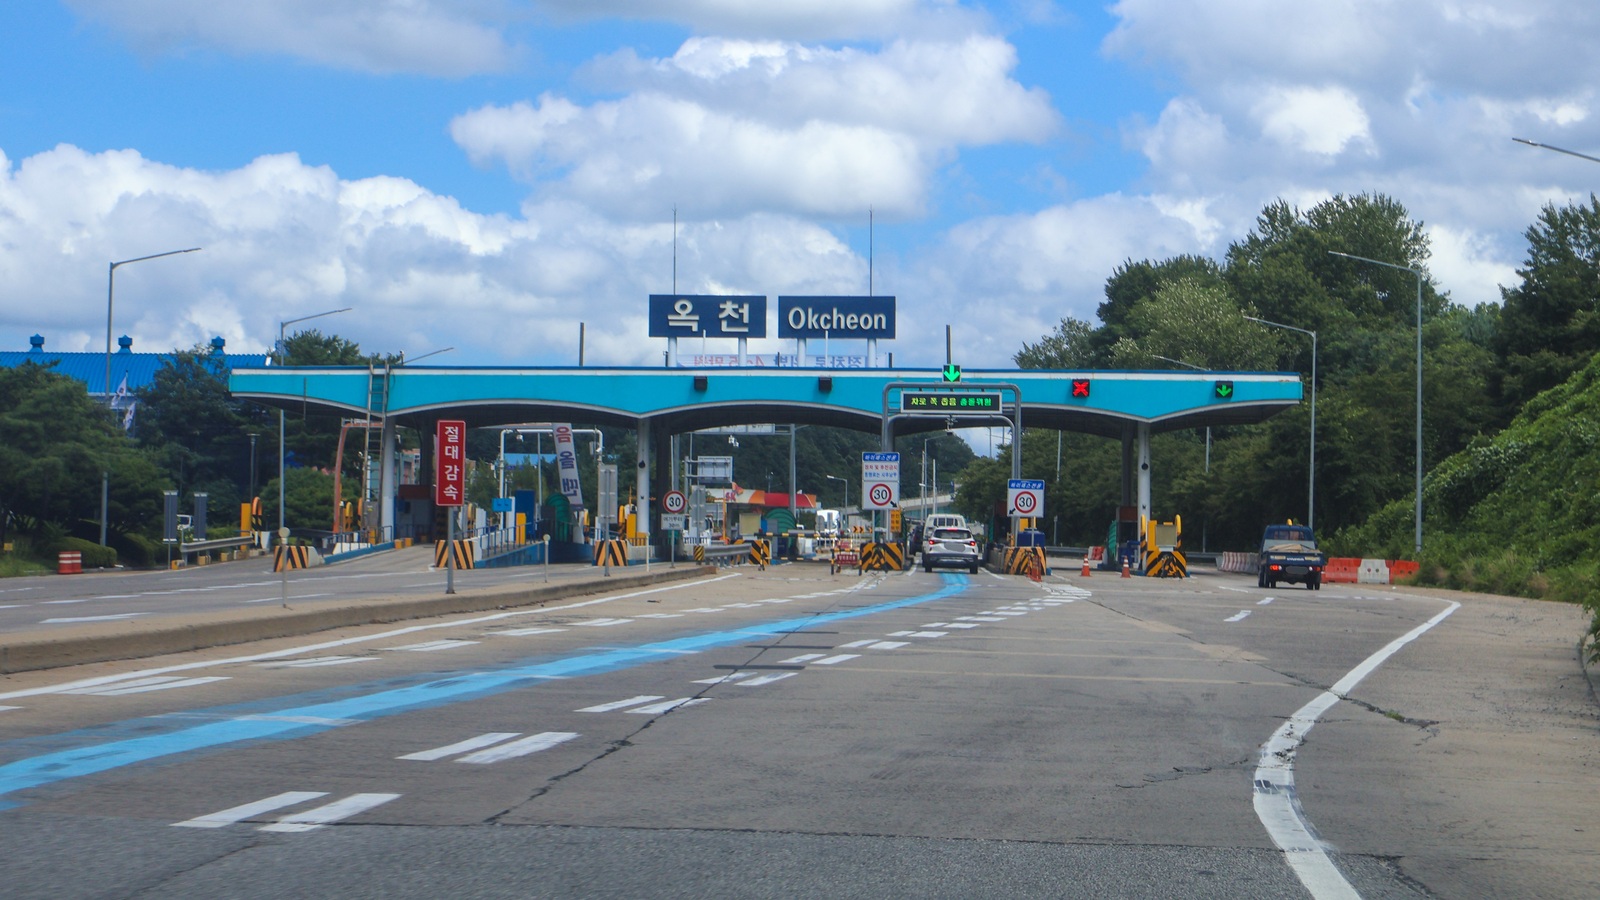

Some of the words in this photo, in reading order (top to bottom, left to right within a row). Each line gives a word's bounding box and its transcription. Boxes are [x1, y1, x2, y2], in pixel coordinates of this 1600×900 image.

[667, 298, 750, 333] 옥천
[787, 305, 887, 331] Okcheon
[874, 489, 888, 500] 30
[669, 496, 681, 507] 30
[1018, 496, 1032, 508] 30
